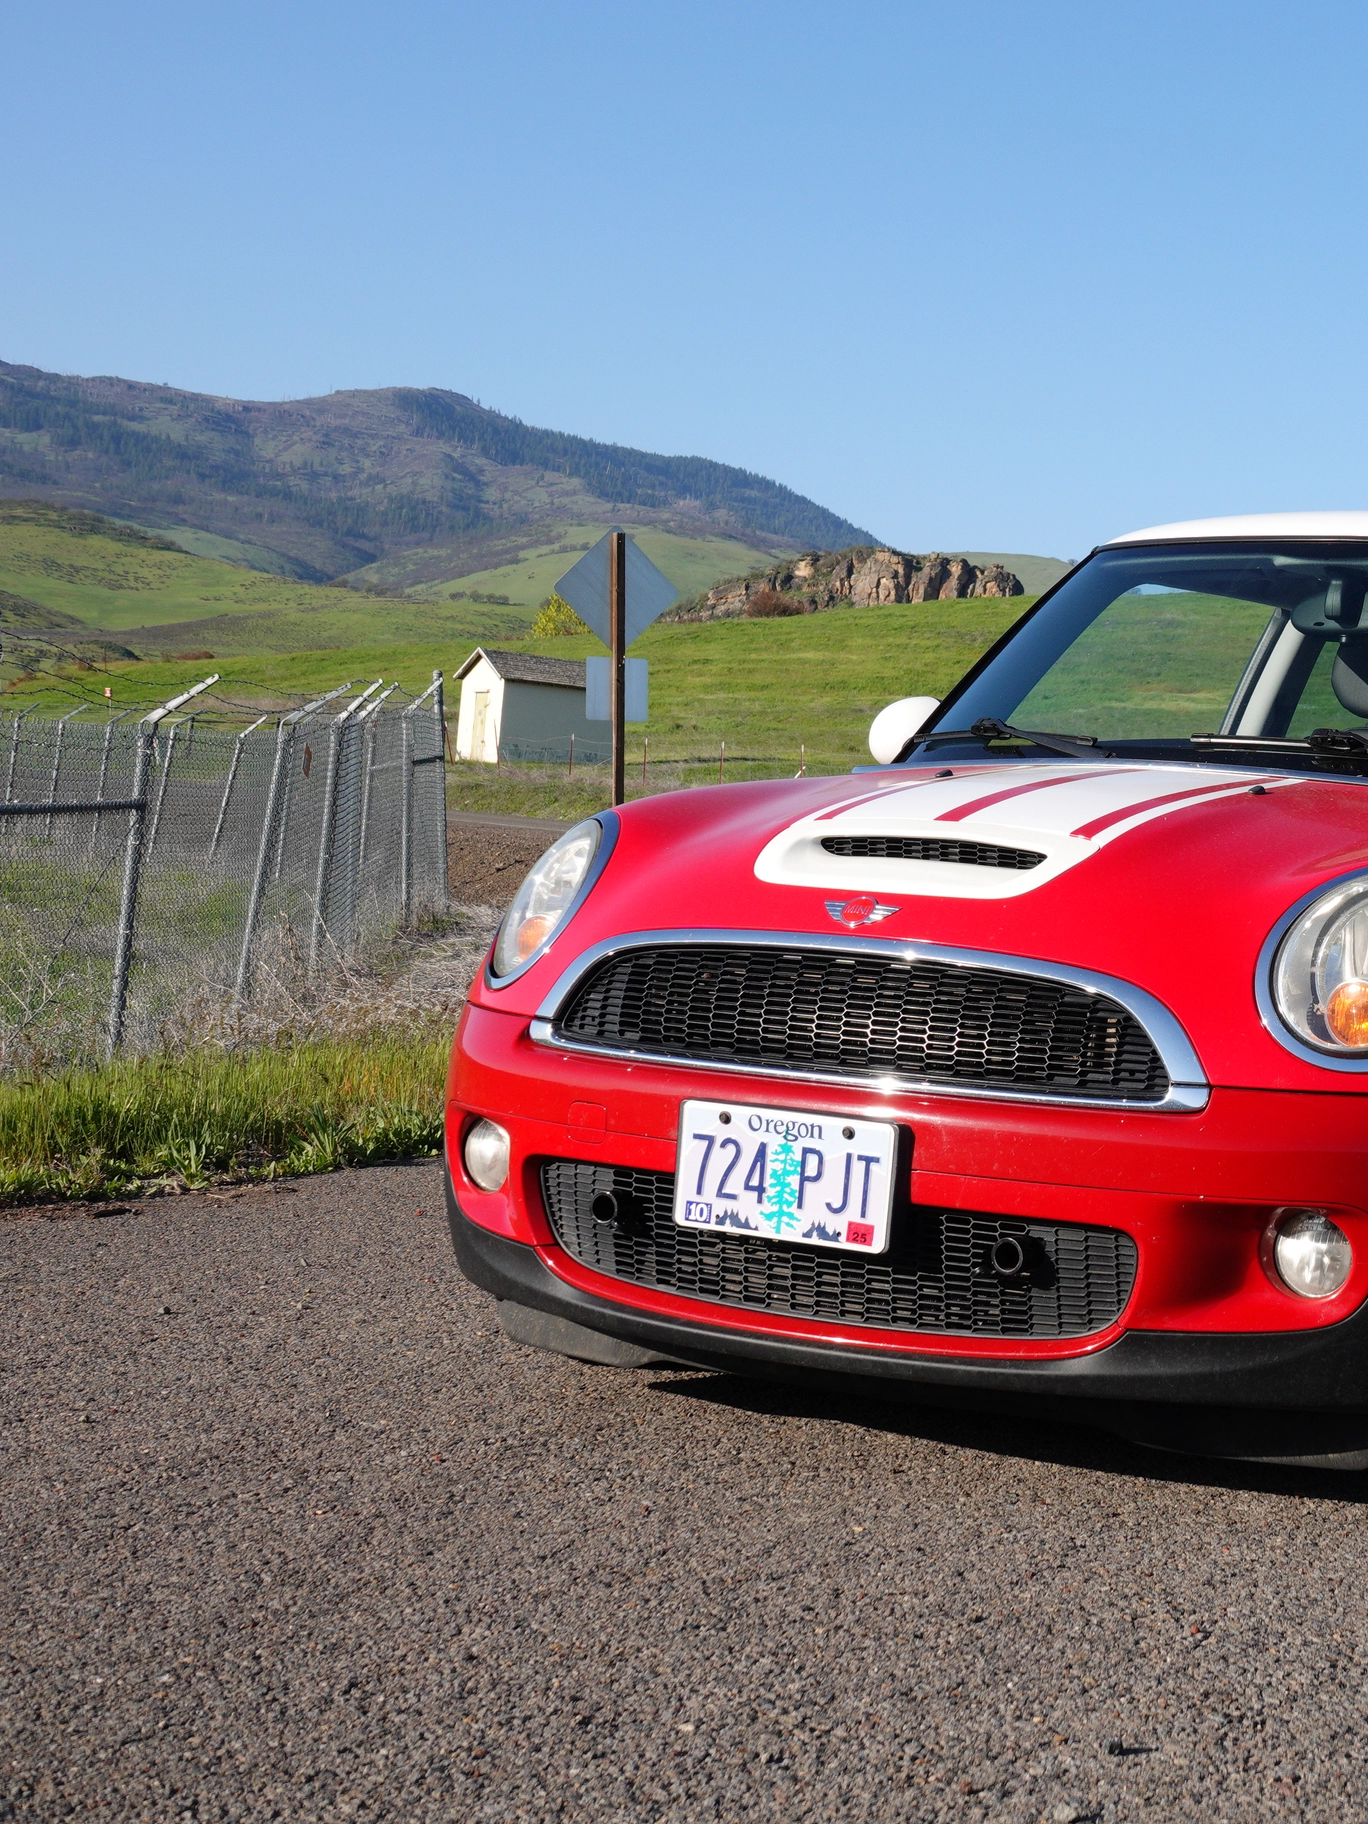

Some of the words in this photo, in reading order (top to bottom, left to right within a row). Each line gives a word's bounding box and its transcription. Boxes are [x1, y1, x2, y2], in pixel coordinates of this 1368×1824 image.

[844, 904, 871, 915] MINI
[748, 1114, 824, 1142] Oregon
[692, 1133, 768, 1204] 724
[796, 1146, 881, 1219] PJT
[688, 1203, 708, 1222] 10
[851, 1231, 867, 1243] 25
